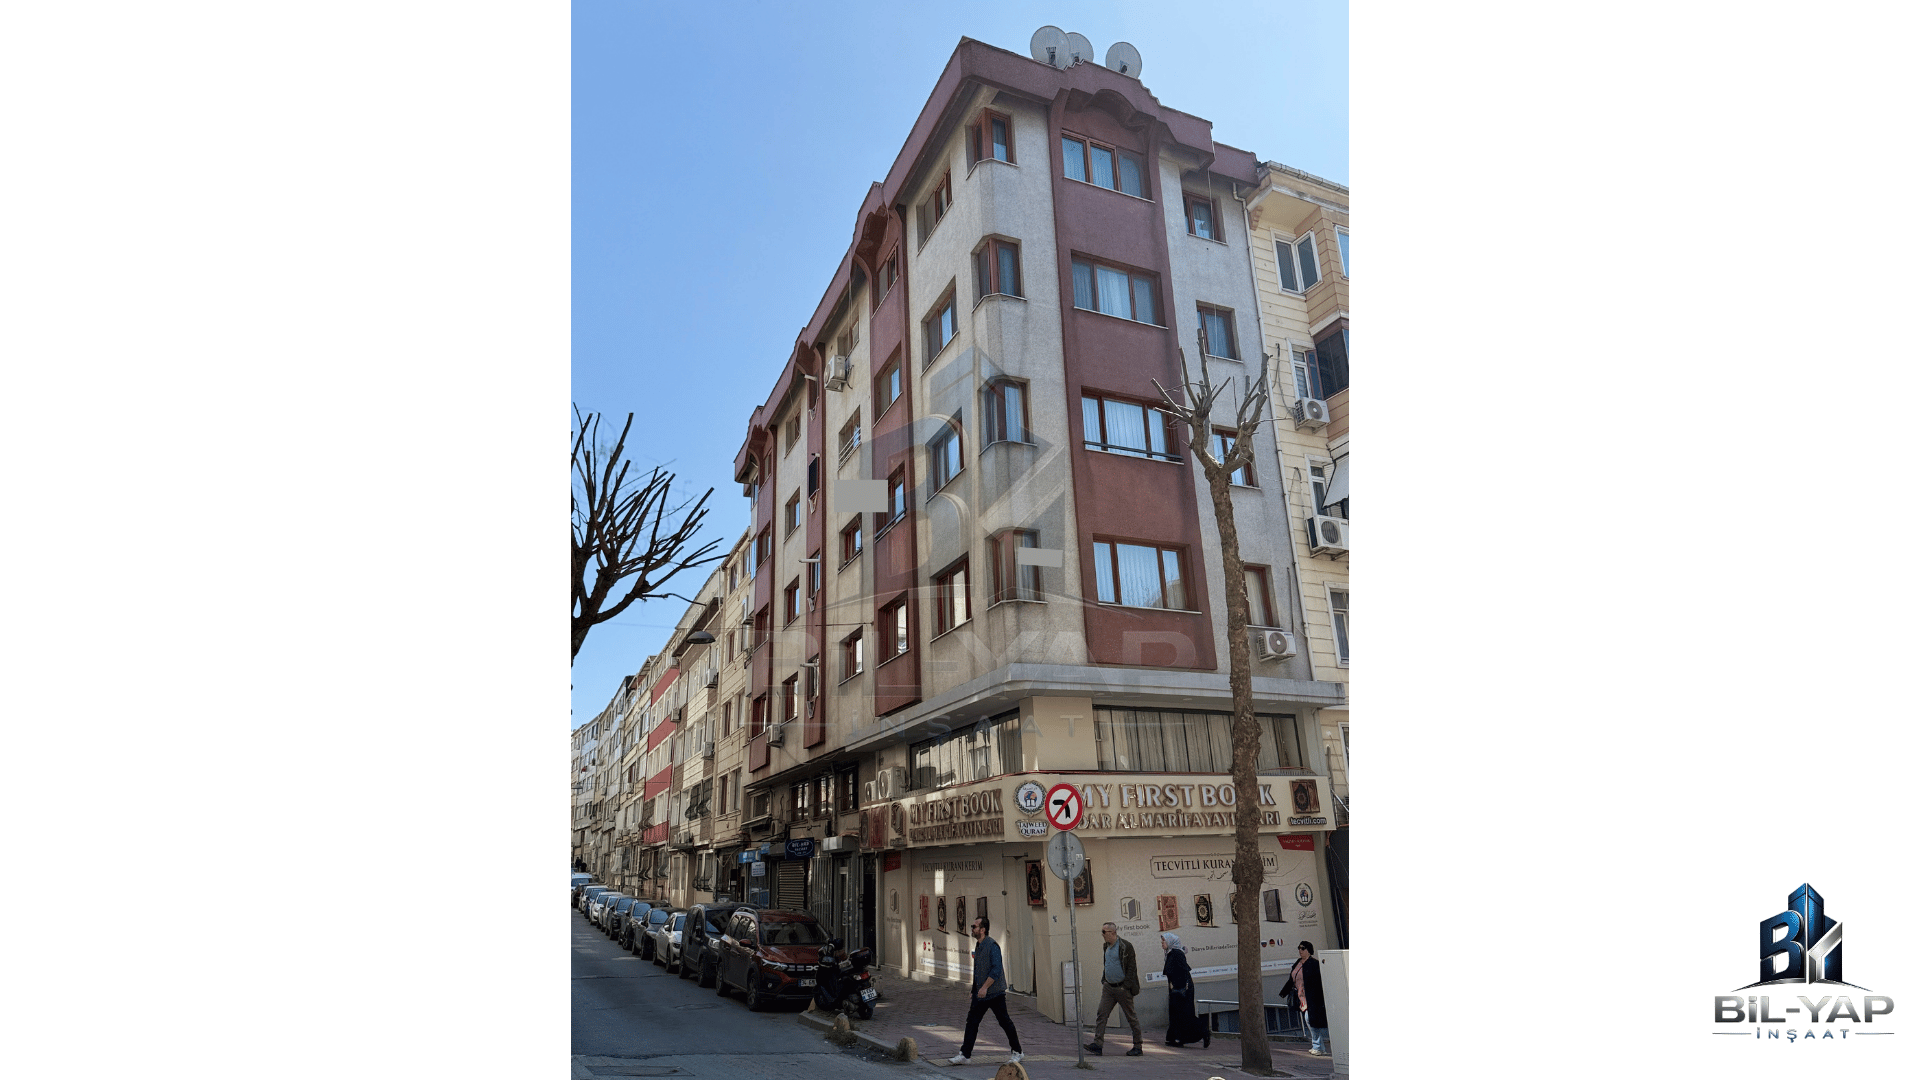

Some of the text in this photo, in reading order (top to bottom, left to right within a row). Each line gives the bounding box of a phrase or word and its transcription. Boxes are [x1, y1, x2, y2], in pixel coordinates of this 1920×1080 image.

[1119, 783, 1195, 808] FIRST
[1198, 783, 1277, 808] BOK
[928, 795, 961, 822] FIRST
[961, 788, 1003, 817] BOOK
[1018, 821, 1048, 829] TAJWEED
[1290, 817, 1327, 826] tecvitli.com
[1020, 828, 1046, 837] QURAN
[1153, 858, 1200, 871] TECVİTLİ
